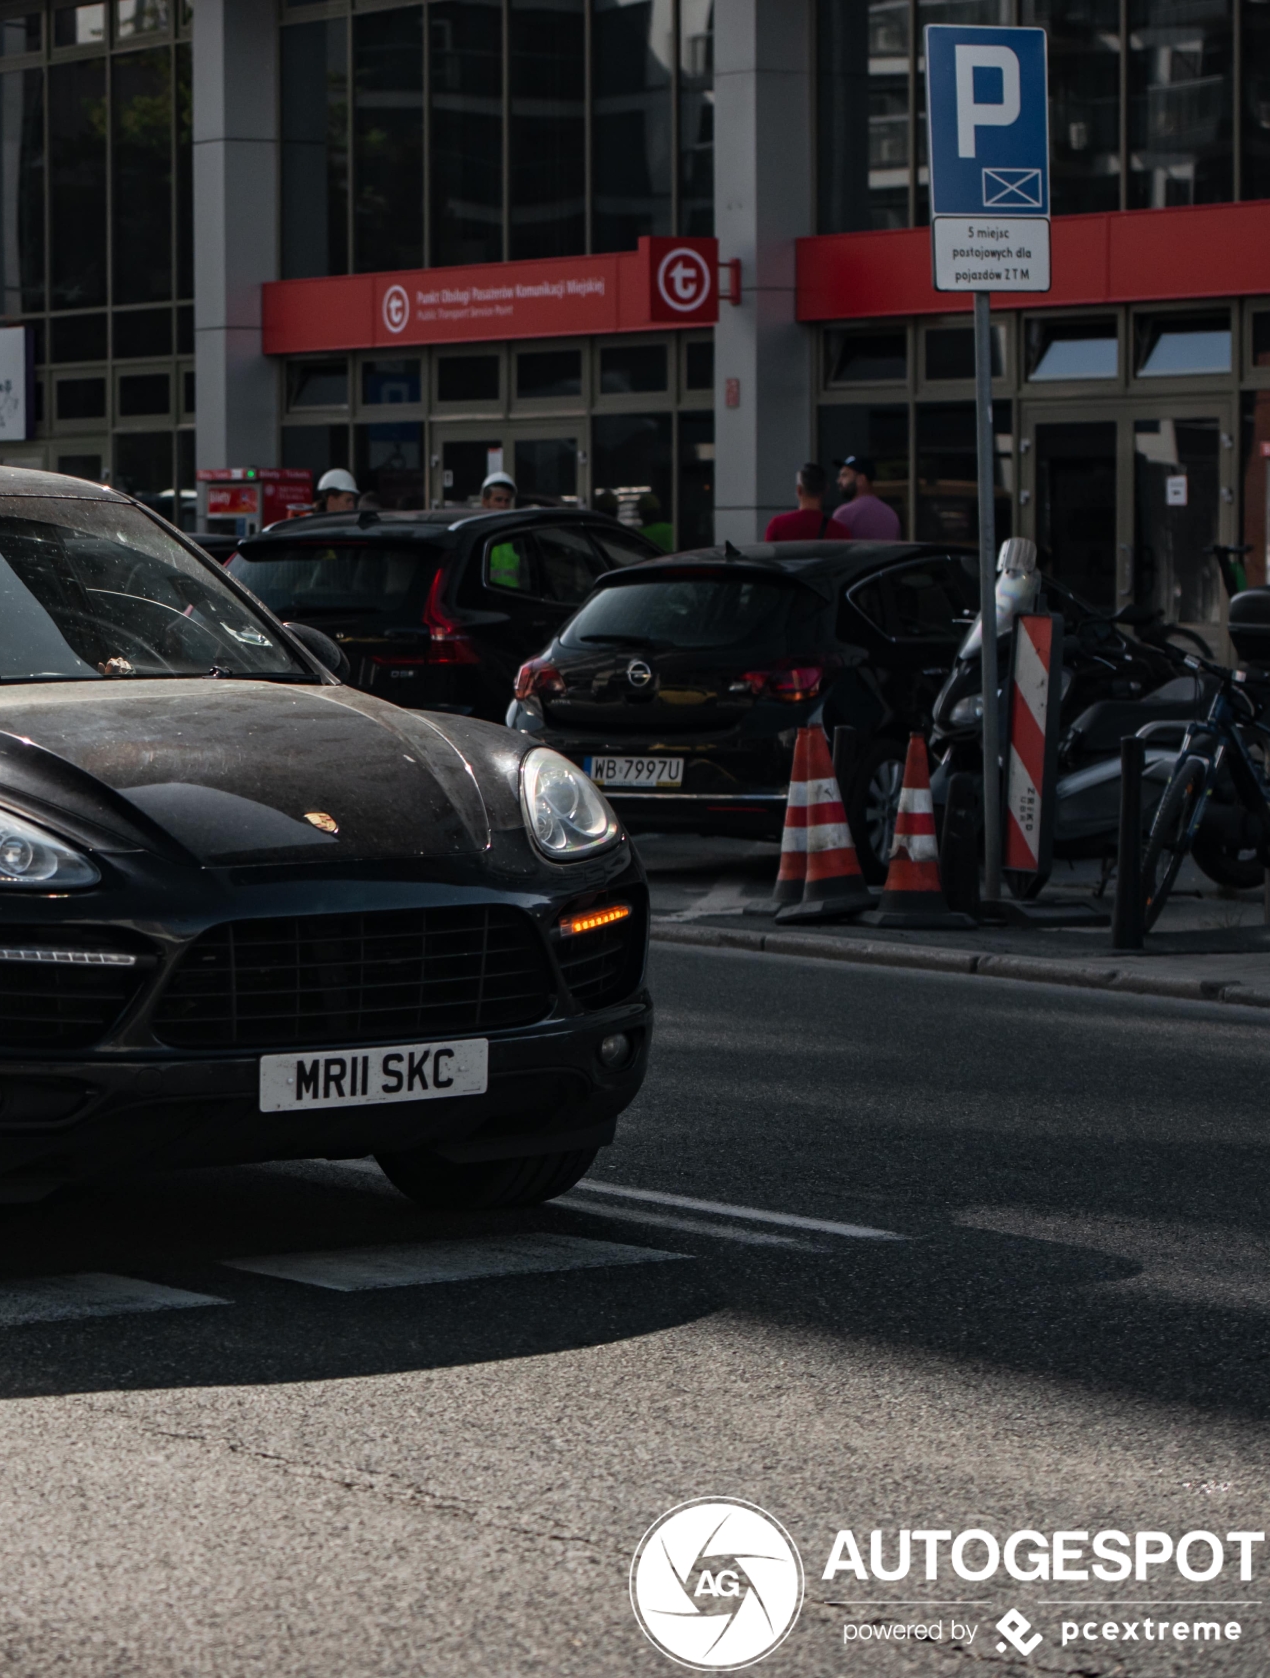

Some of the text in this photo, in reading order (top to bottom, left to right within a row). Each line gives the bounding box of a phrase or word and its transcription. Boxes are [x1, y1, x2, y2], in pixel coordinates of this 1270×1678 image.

[955, 44, 1021, 158] P
[968, 226, 1010, 241] 5 miejsc
[952, 246, 1032, 261] postojowych dla
[955, 268, 1002, 283] pojazdów
[416, 290, 440, 304] Punkt
[515, 280, 564, 300] Komunikacji
[565, 276, 605, 296] Miejskiej
[437, 307, 470, 321] Transport
[470, 305, 494, 317] Service
[595, 758, 680, 781] WB 7997U
[296, 1048, 455, 1101] MR11 SKC
